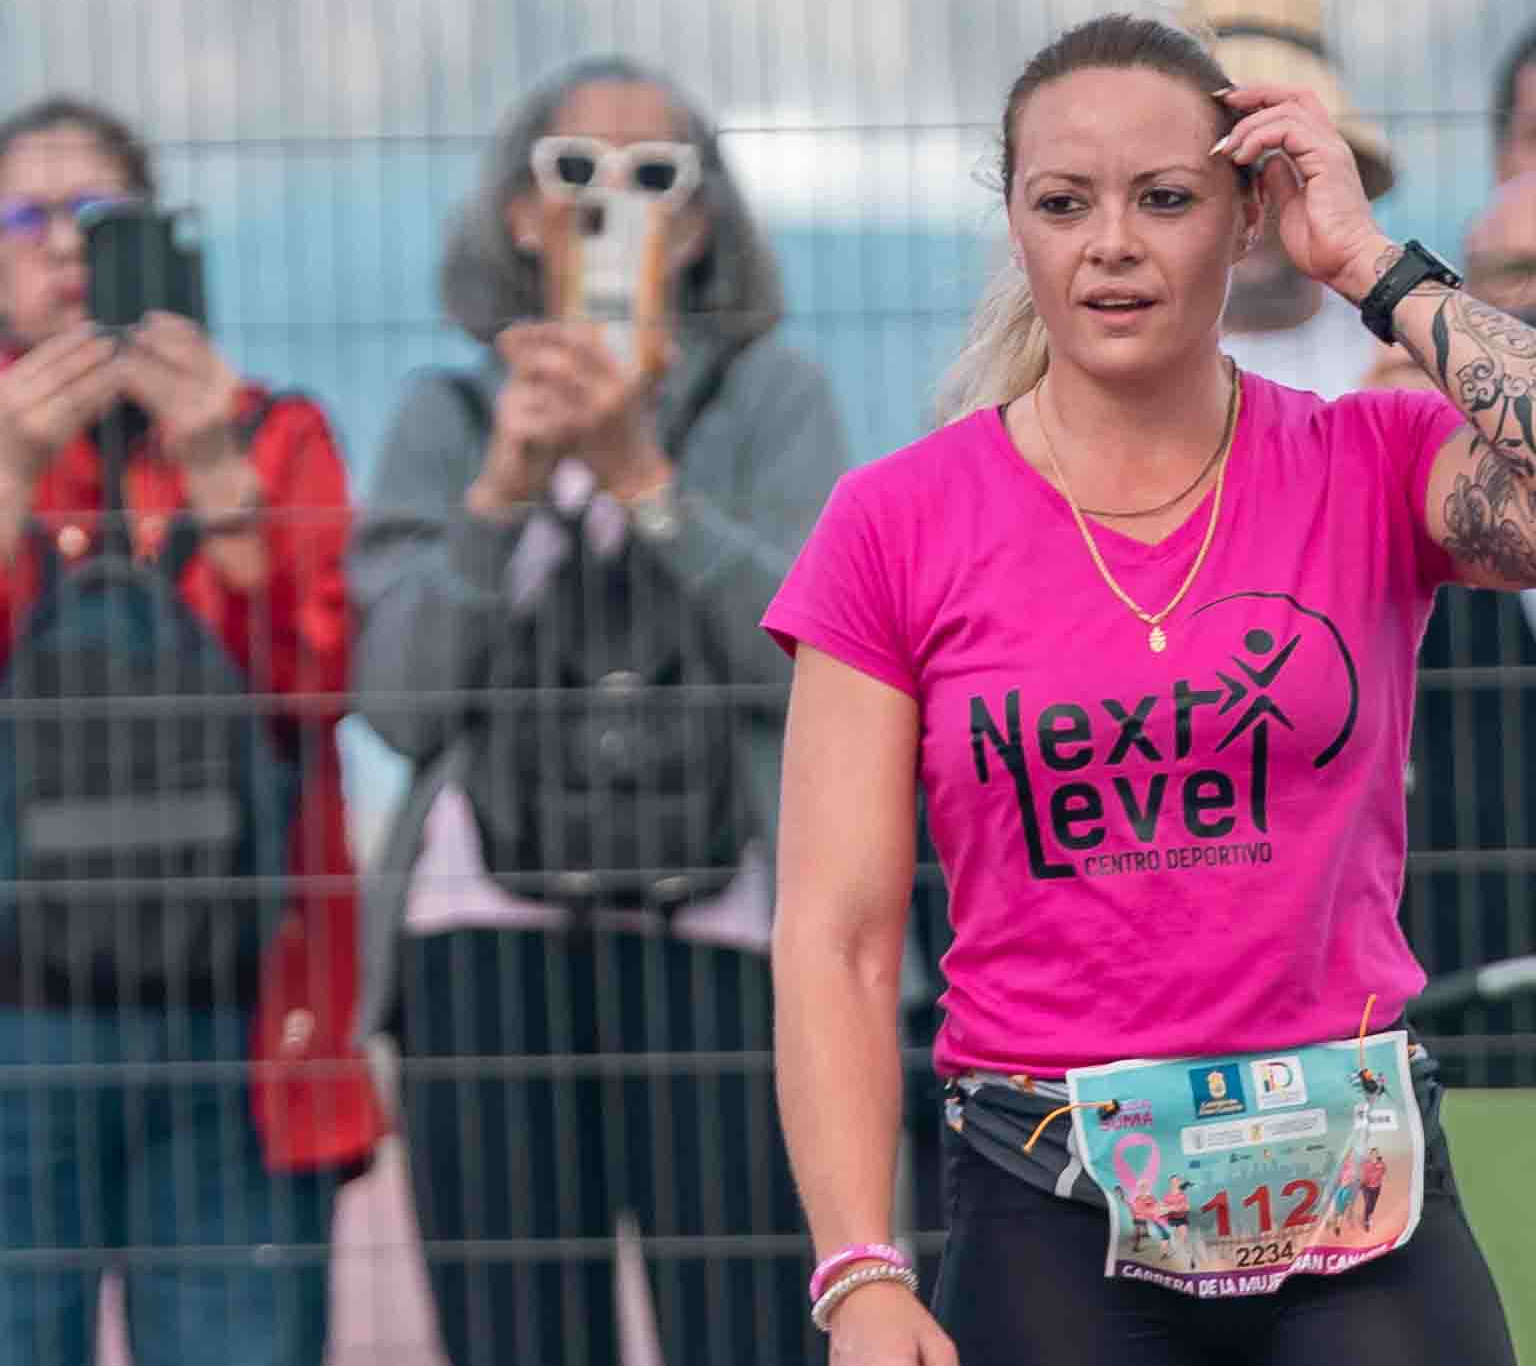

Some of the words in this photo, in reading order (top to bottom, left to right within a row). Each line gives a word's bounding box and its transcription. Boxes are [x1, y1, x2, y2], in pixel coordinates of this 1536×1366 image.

[969, 677, 1230, 784] Next
[1010, 719, 1269, 880] Level
[1084, 849, 1161, 877] CENTRO
[1166, 841, 1273, 871] DEPORTIVO
[1201, 1178, 1322, 1238] 112
[1235, 1240, 1295, 1269] 2234
[1199, 1276, 1218, 1299] DE
